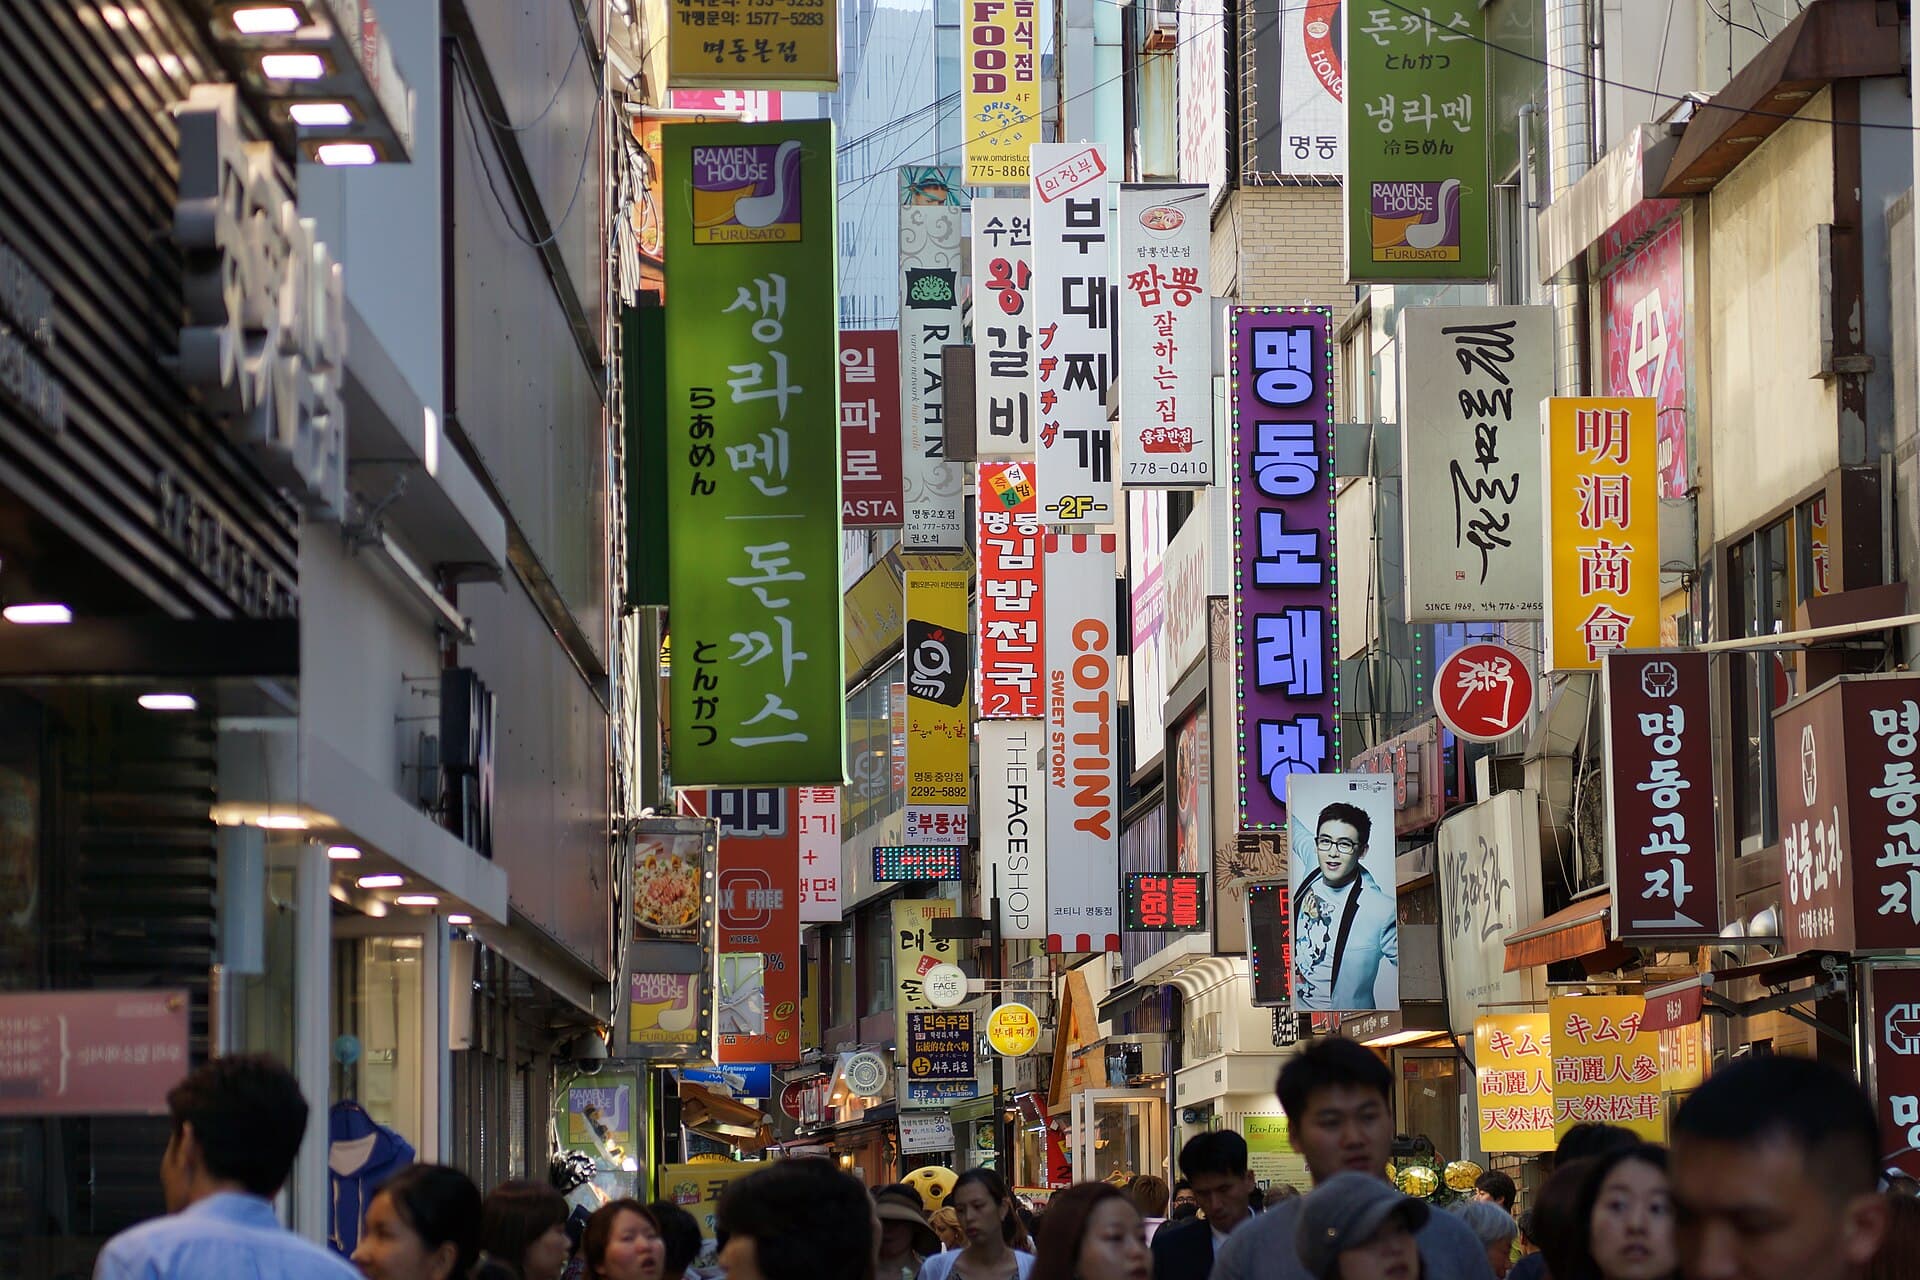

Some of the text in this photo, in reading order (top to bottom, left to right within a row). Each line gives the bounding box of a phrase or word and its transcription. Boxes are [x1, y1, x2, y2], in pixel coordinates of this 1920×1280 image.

[677, 11, 824, 26] 가맹문의: 1577-5283
[1360, 8, 1475, 46] 돈까스
[703, 38, 798, 64] 명동본점
[972, 2, 1007, 94] FOOD
[1385, 54, 1450, 70] とんかつ
[983, 101, 1022, 117] DRISTI
[1365, 93, 1472, 133] 냉라멘
[693, 147, 757, 166] RAMEN
[1289, 136, 1337, 160] 명동
[1384, 140, 1454, 156] 冷らめん
[708, 163, 768, 182] HOUSE
[1044, 158, 1092, 193] 의정부
[1373, 184, 1424, 198] RAMEN
[1384, 197, 1433, 211] HOUSE
[983, 216, 1031, 248] 수원
[1127, 264, 1203, 307] 짬뽕
[1061, 198, 1112, 483] 부대찌개
[721, 273, 803, 497] 생라멘
[689, 386, 716, 496] らあめん
[1141, 427, 1193, 445] 홍콩반점
[1130, 461, 1208, 475] 778-0410
[842, 500, 897, 517] ASTA
[911, 509, 955, 520] 명동2호점
[906, 523, 919, 531] Tel
[983, 511, 1039, 536] 명동
[1574, 408, 1634, 663] 明洞商會
[1252, 326, 1327, 808] 명동노래방
[985, 538, 1038, 693] 김밥천국
[1425, 603, 1451, 611] SINCE
[726, 541, 809, 748] 돈까스
[691, 640, 719, 747] とんかつ
[1051, 670, 1066, 789] SWEET STORY
[1072, 618, 1111, 841] COTTINY
[914, 771, 964, 783] 명동중앙점
[911, 787, 967, 798] 2292-5892
[1636, 704, 1694, 908] 명동교자
[918, 813, 967, 835] 부동산
[1784, 805, 1842, 905] 명동교자
[718, 889, 784, 910] AX FREE
[1054, 906, 1113, 917] 코티니 명동점
[729, 934, 760, 944] KOREA
[632, 974, 677, 987] RAMEN
[933, 982, 957, 990] FACE
[640, 984, 685, 1000] HOUSE
[934, 990, 959, 999] SHOP
[923, 1014, 970, 1031] 민속주점
[1566, 1013, 1641, 1044] キムチ
[569, 1089, 606, 1099] RAMEN
[1557, 1094, 1660, 1123] 天然松茸
